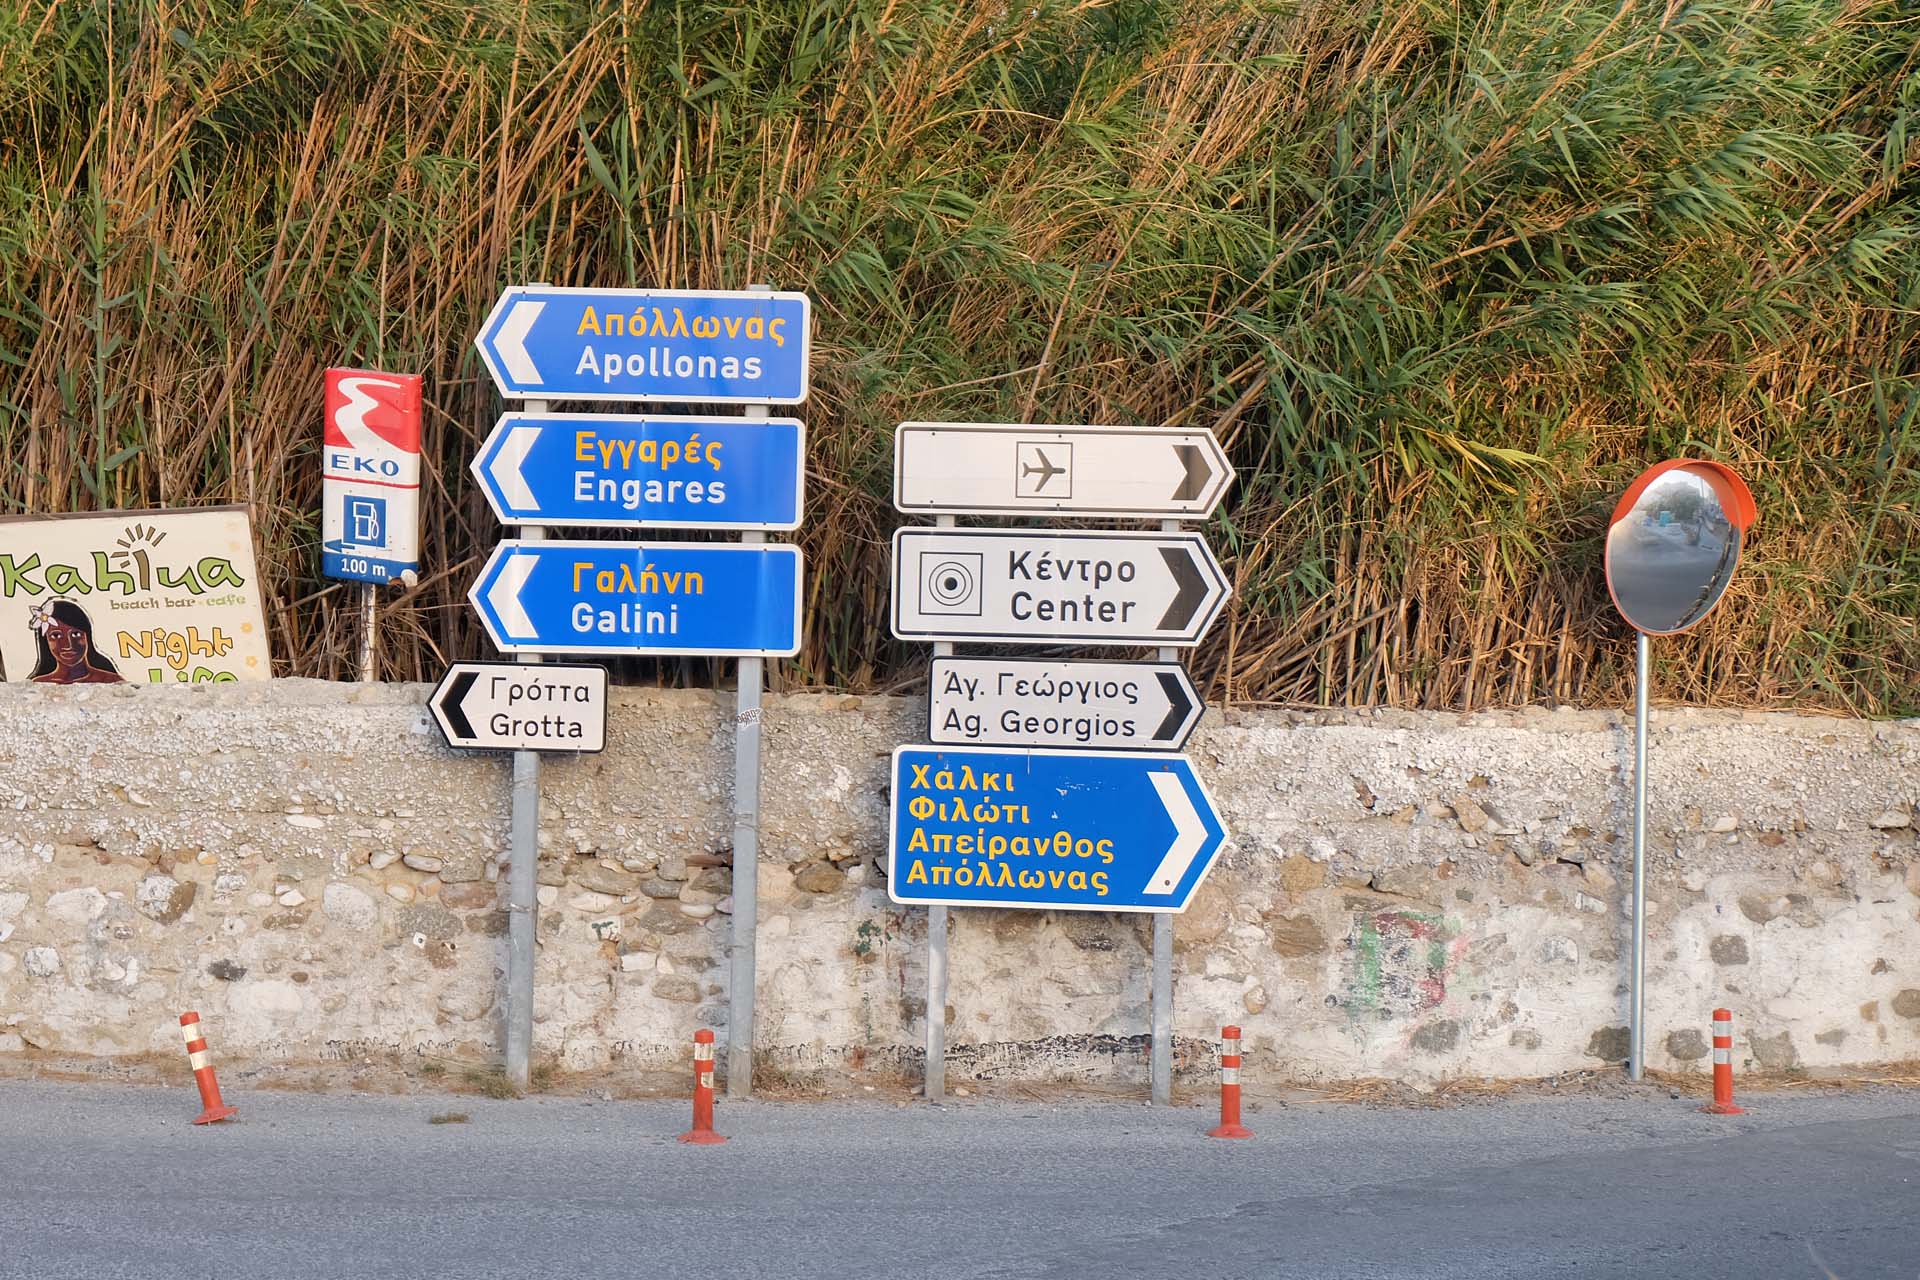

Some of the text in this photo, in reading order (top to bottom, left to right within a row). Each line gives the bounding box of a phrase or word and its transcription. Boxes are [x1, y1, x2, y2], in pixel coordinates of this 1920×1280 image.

[576, 306, 786, 346] Απόλλωνας
[575, 346, 763, 383] Apollonas
[331, 454, 399, 476] EKO
[575, 431, 724, 469] Εγγαρές
[574, 471, 727, 509] Engares
[341, 558, 386, 577] 100 m
[572, 562, 704, 594] Γαλήνη
[1009, 550, 1136, 588] Κέντρο
[110, 599, 159, 610] beach
[164, 596, 196, 608] bar
[571, 603, 679, 634] Galini
[1010, 592, 1137, 623] Center
[117, 626, 233, 670] Night
[490, 676, 590, 706] Γρόττα
[997, 671, 1139, 705] Γεώργιος
[490, 714, 583, 738] Grotta
[943, 708, 1136, 742] Ag. Georgios
[908, 795, 1030, 824] Φιλώτι
[907, 827, 1115, 864] Απείρανθος
[906, 858, 1109, 897] Απόλλωνας
